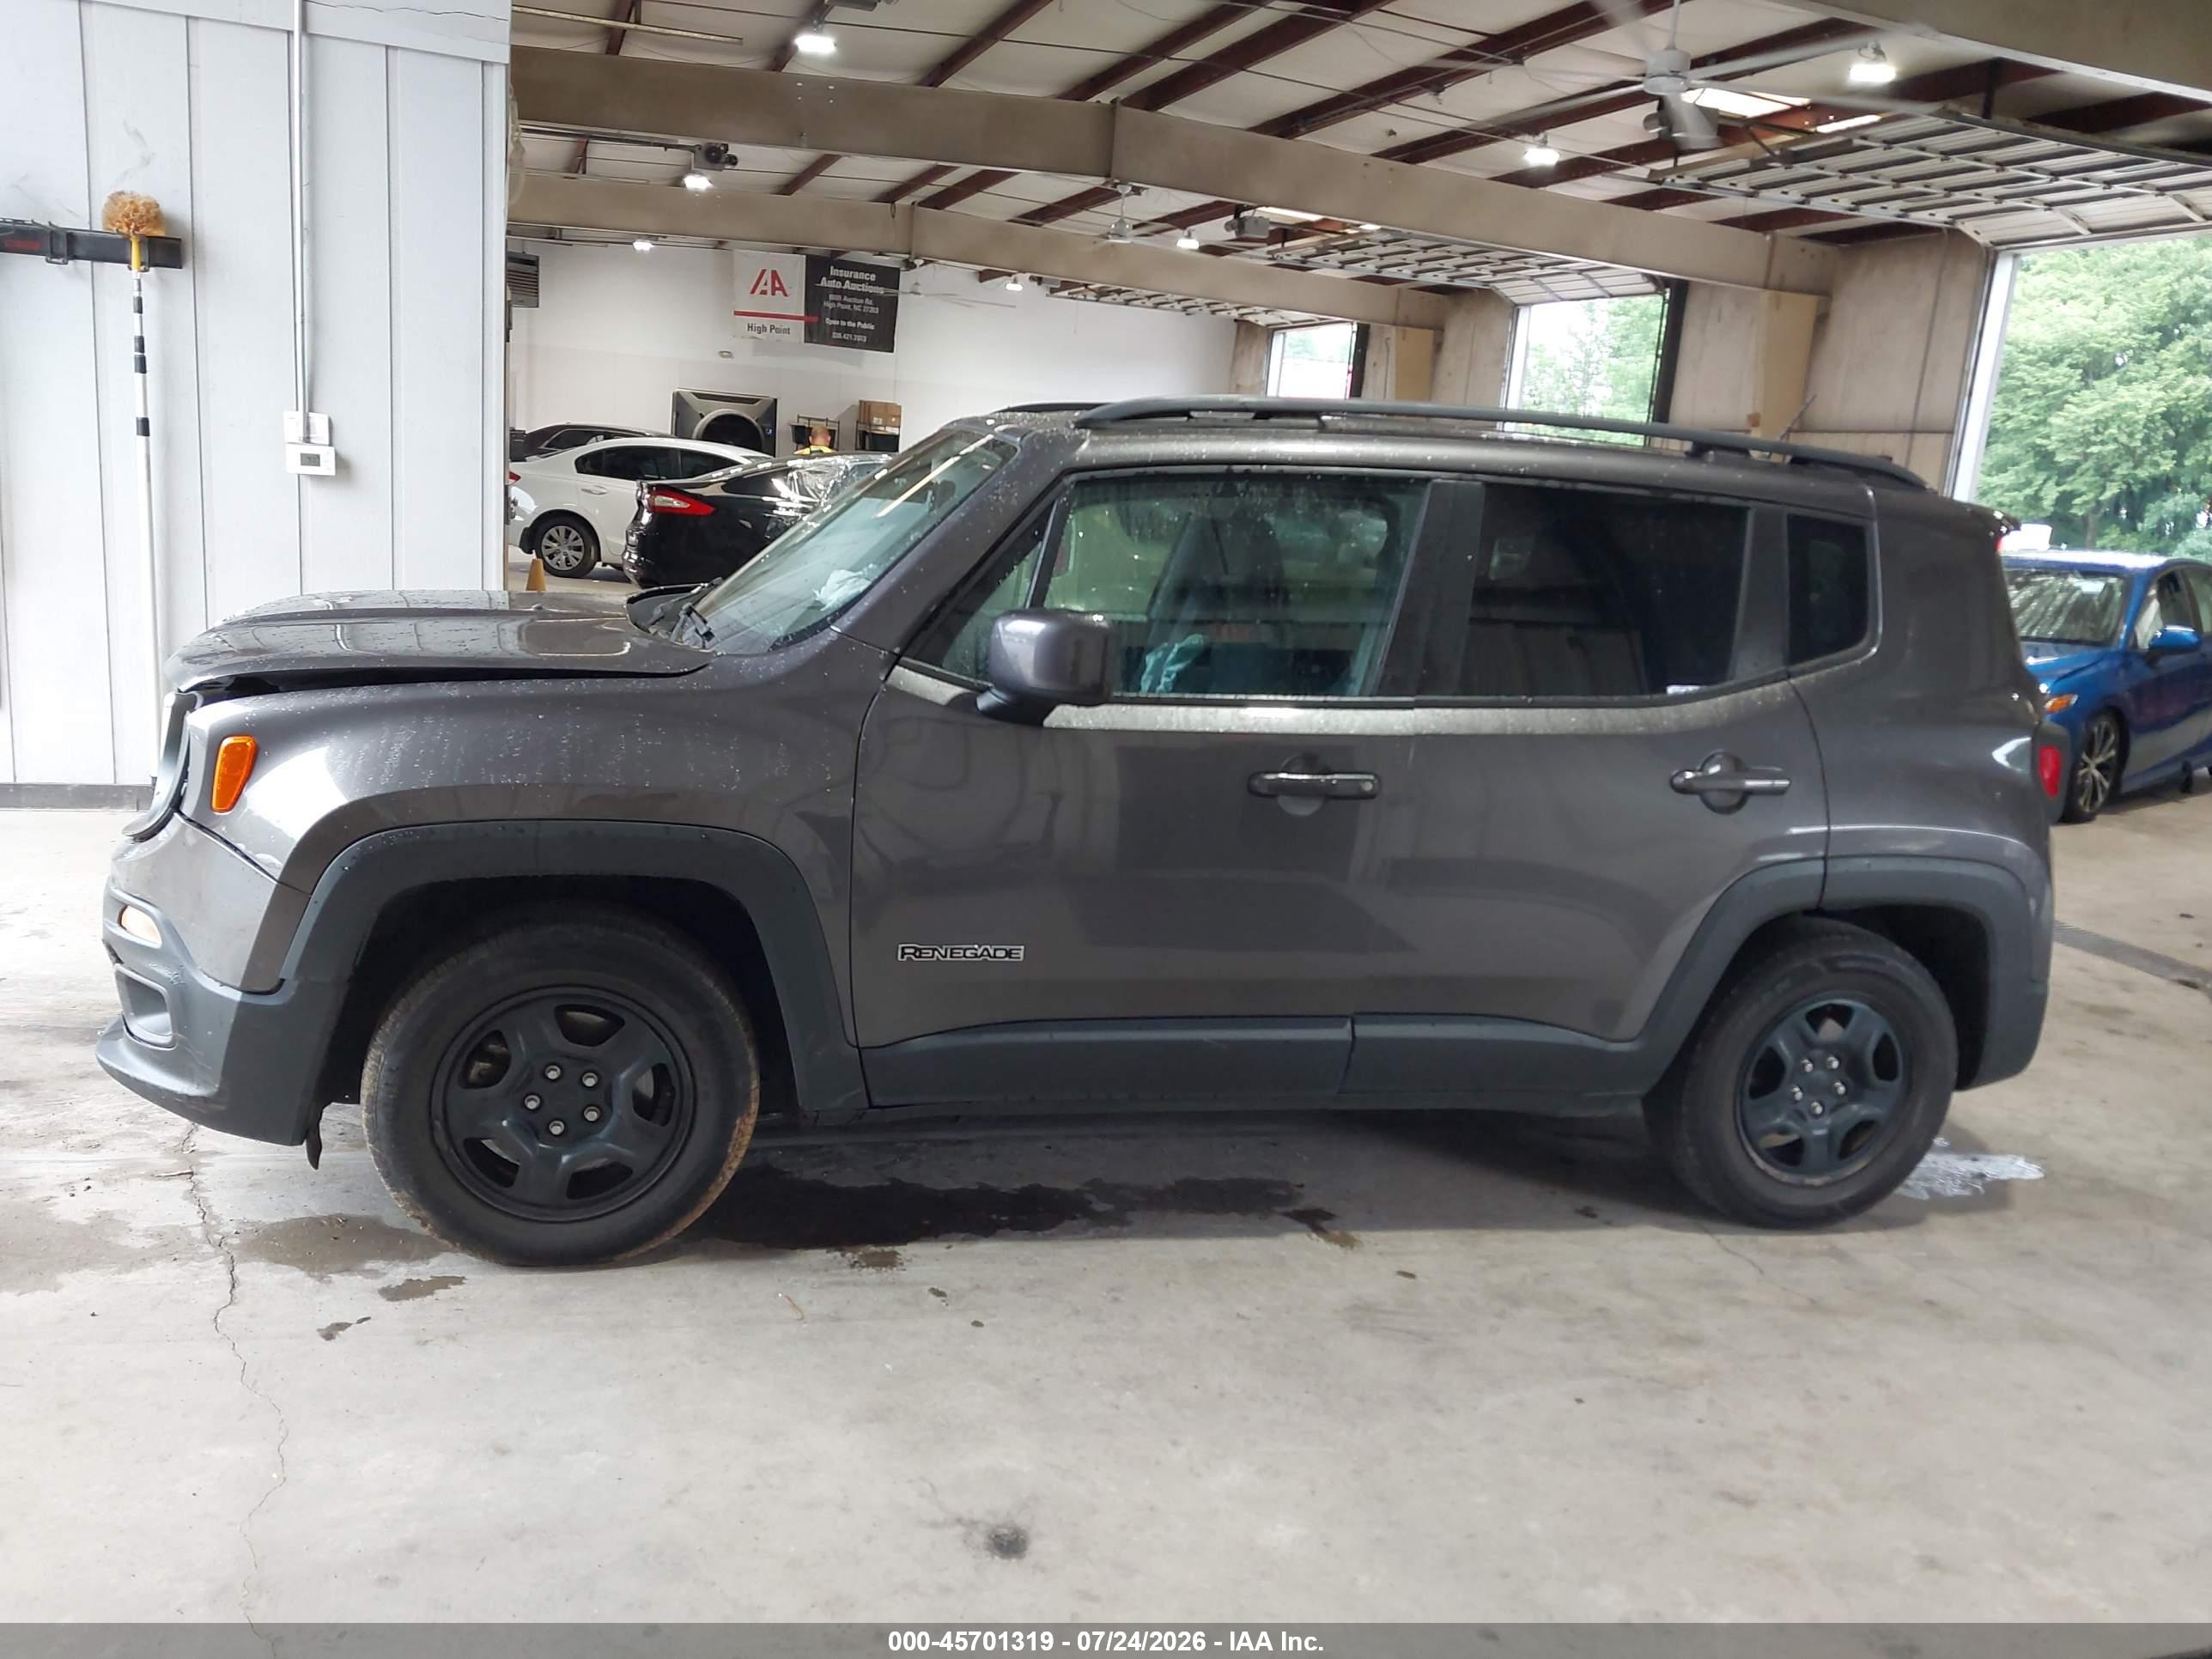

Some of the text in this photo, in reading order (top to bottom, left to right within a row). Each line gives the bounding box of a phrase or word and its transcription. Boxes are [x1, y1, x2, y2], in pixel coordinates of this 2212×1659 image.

[830, 265, 876, 281] Insurance
[820, 276, 884, 294] Auto Auctions
[747, 322, 790, 335] High Point
[898, 944, 1024, 961] RENEGADE
